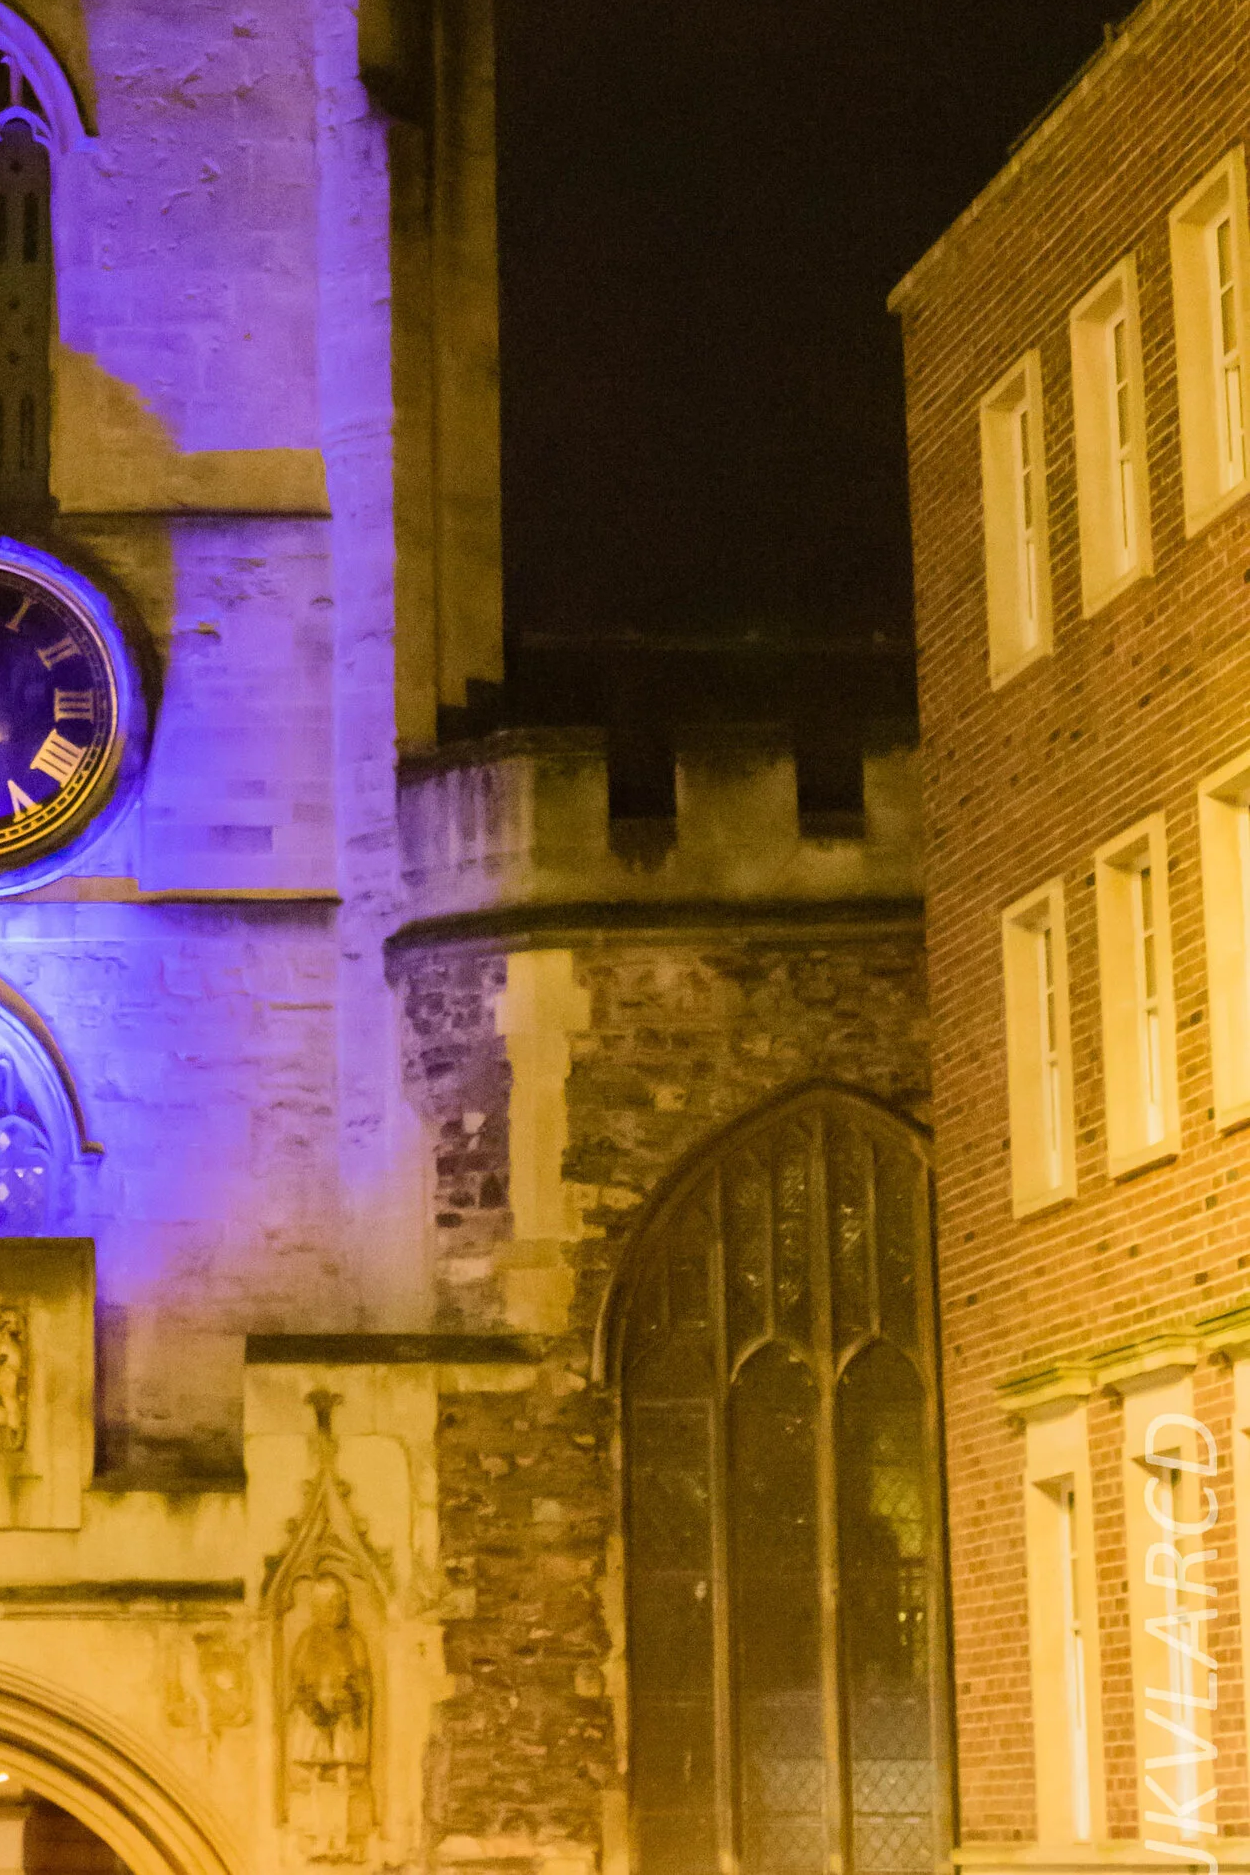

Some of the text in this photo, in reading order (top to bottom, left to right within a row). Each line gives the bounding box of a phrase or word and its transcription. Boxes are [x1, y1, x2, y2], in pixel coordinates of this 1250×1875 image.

[35, 636, 83, 671] II
[54, 687, 94, 723] III
[30, 728, 87, 788] IIII
[7, 779, 43, 824] V
